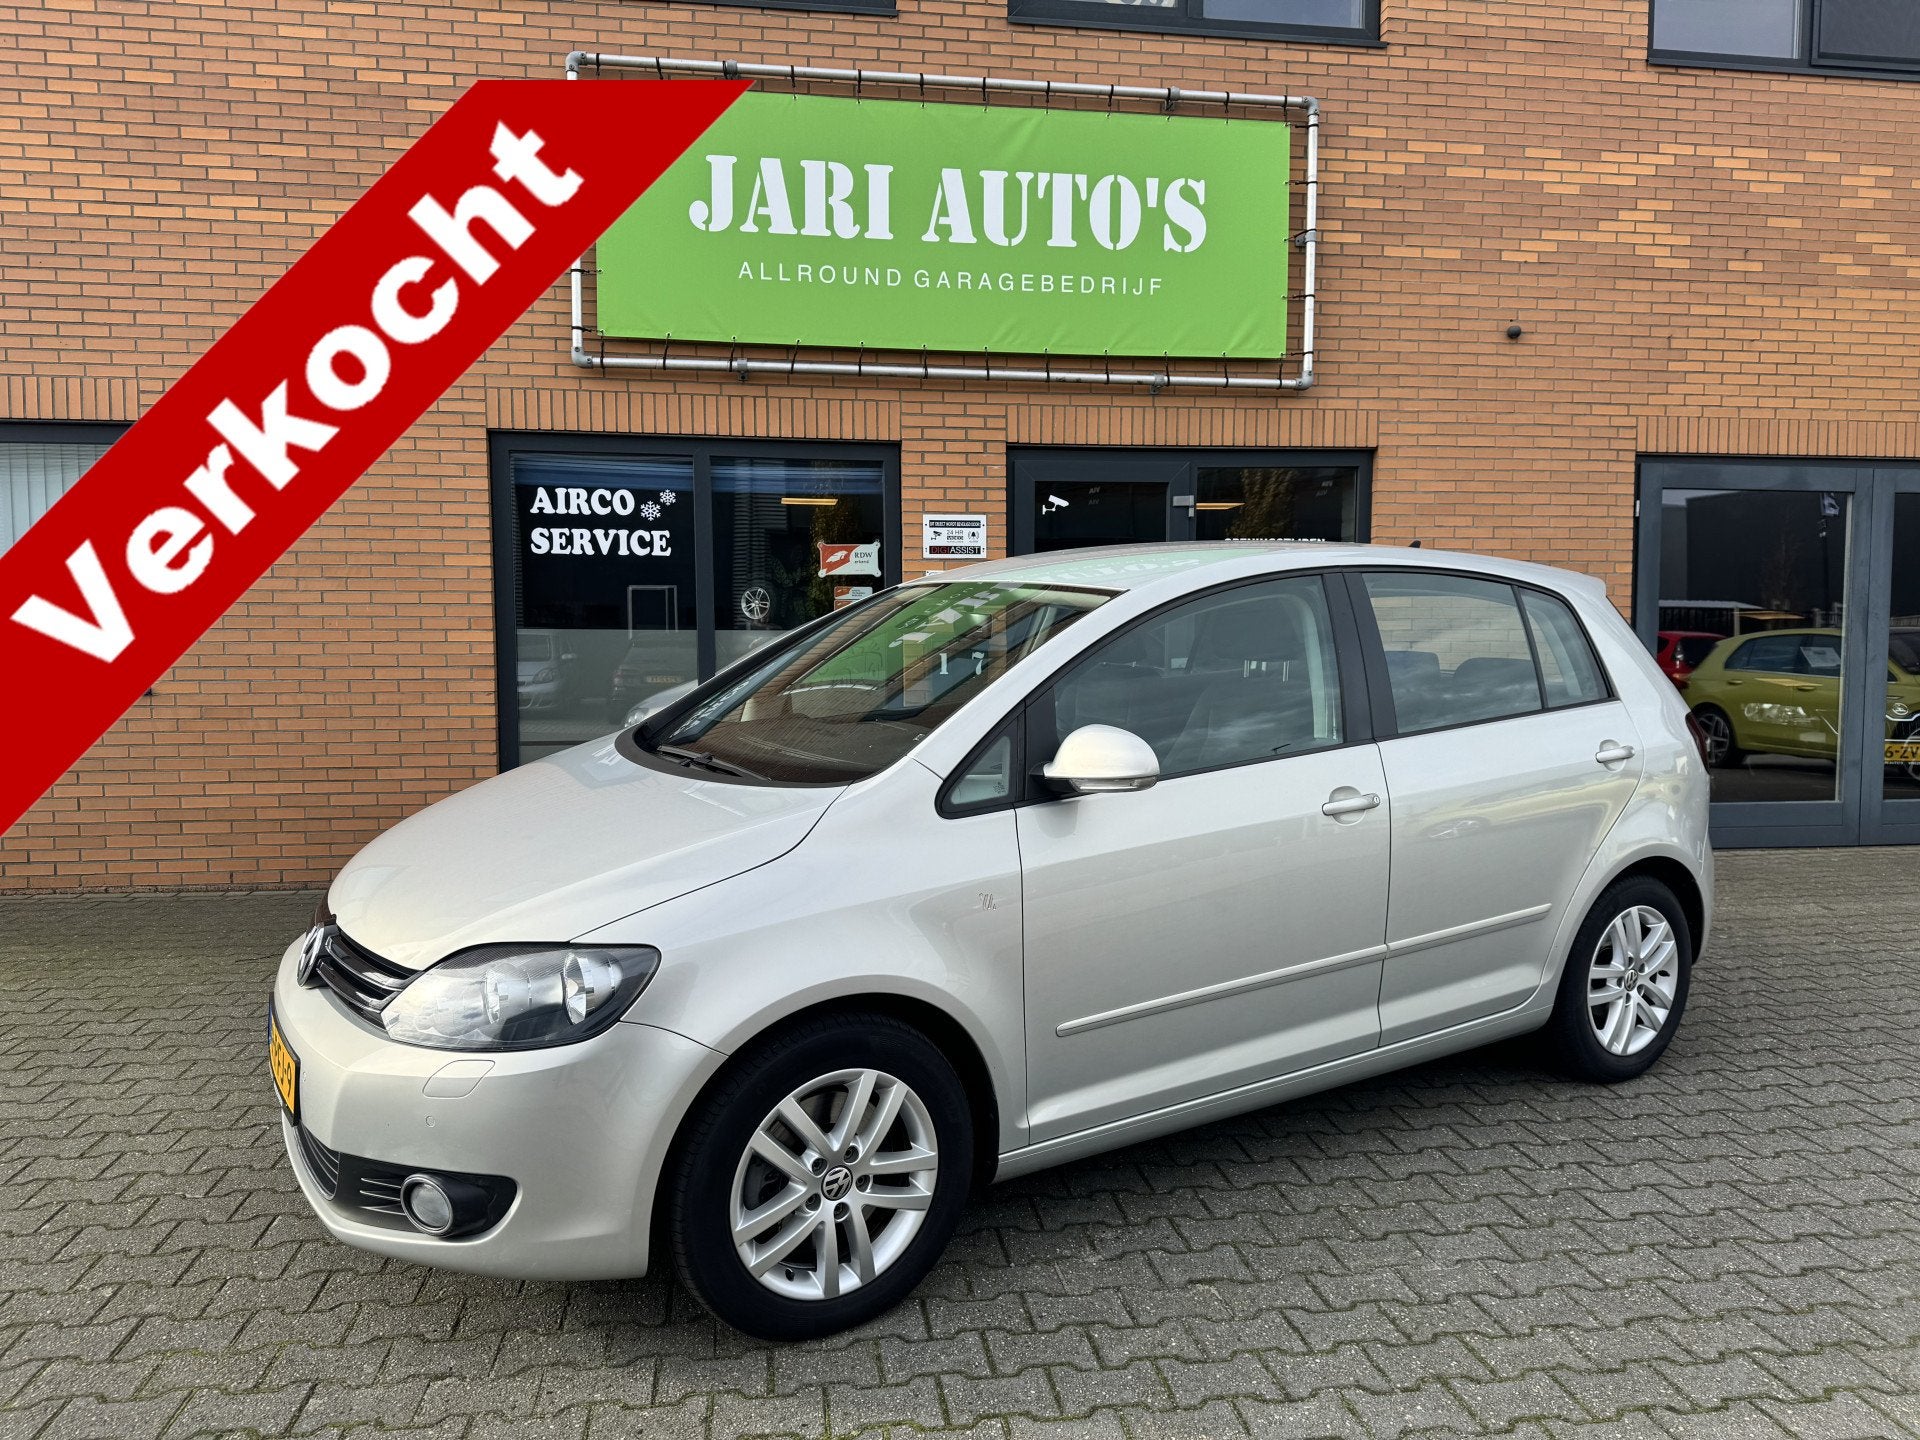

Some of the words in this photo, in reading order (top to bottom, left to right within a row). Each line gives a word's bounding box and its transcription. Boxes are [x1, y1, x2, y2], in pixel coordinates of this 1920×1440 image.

[688, 154, 895, 241] JARI
[921, 167, 1207, 253] AUTO'S
[738, 261, 902, 287] ALLROUND
[913, 269, 1163, 296] GARAGEBEDRIJF
[529, 486, 636, 516] AIRCO
[530, 527, 672, 557] SERVICE
[931, 546, 979, 554] DIGIASSIST
